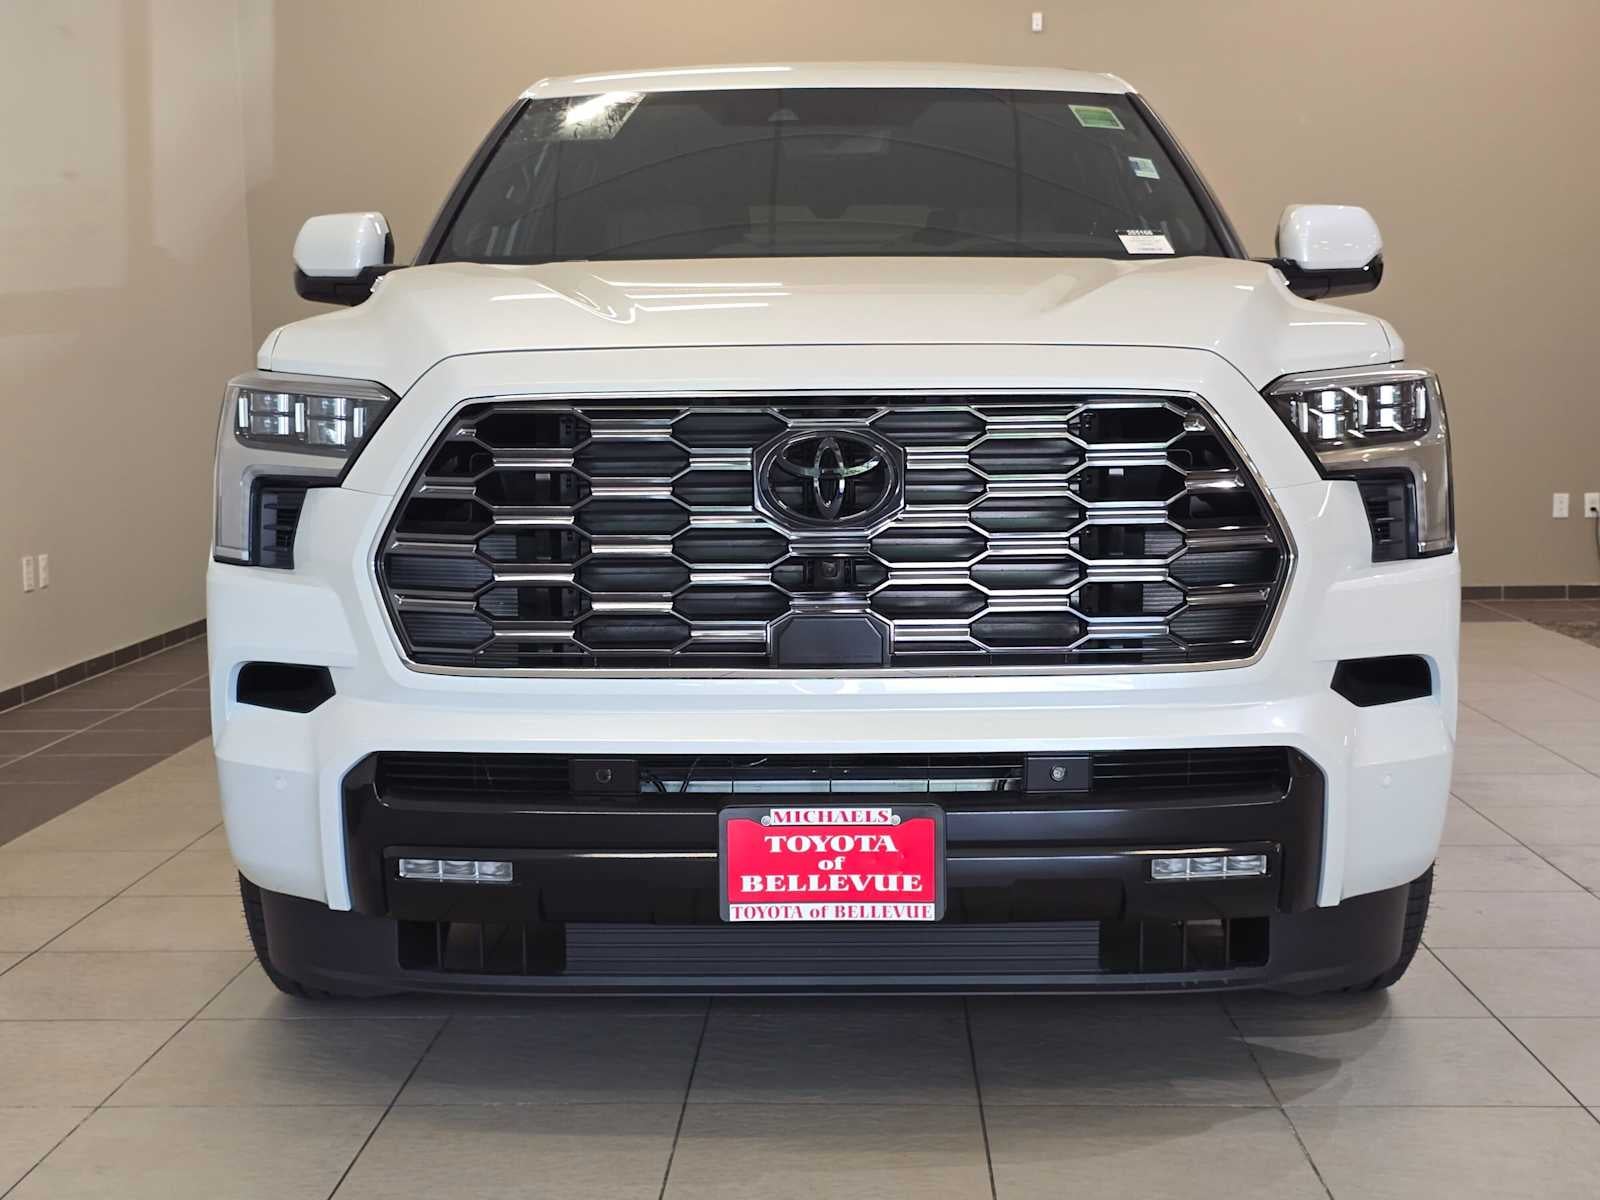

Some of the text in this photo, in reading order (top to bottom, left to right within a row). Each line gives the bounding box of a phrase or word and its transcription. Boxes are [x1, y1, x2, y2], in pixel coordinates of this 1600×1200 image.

[773, 810, 889, 823] MICHAELS
[764, 835, 898, 852] TOYOTA
[818, 856, 845, 870] of
[741, 875, 922, 892] BELLEVUE
[731, 905, 933, 919] TOYOTA of BELLEVUE
